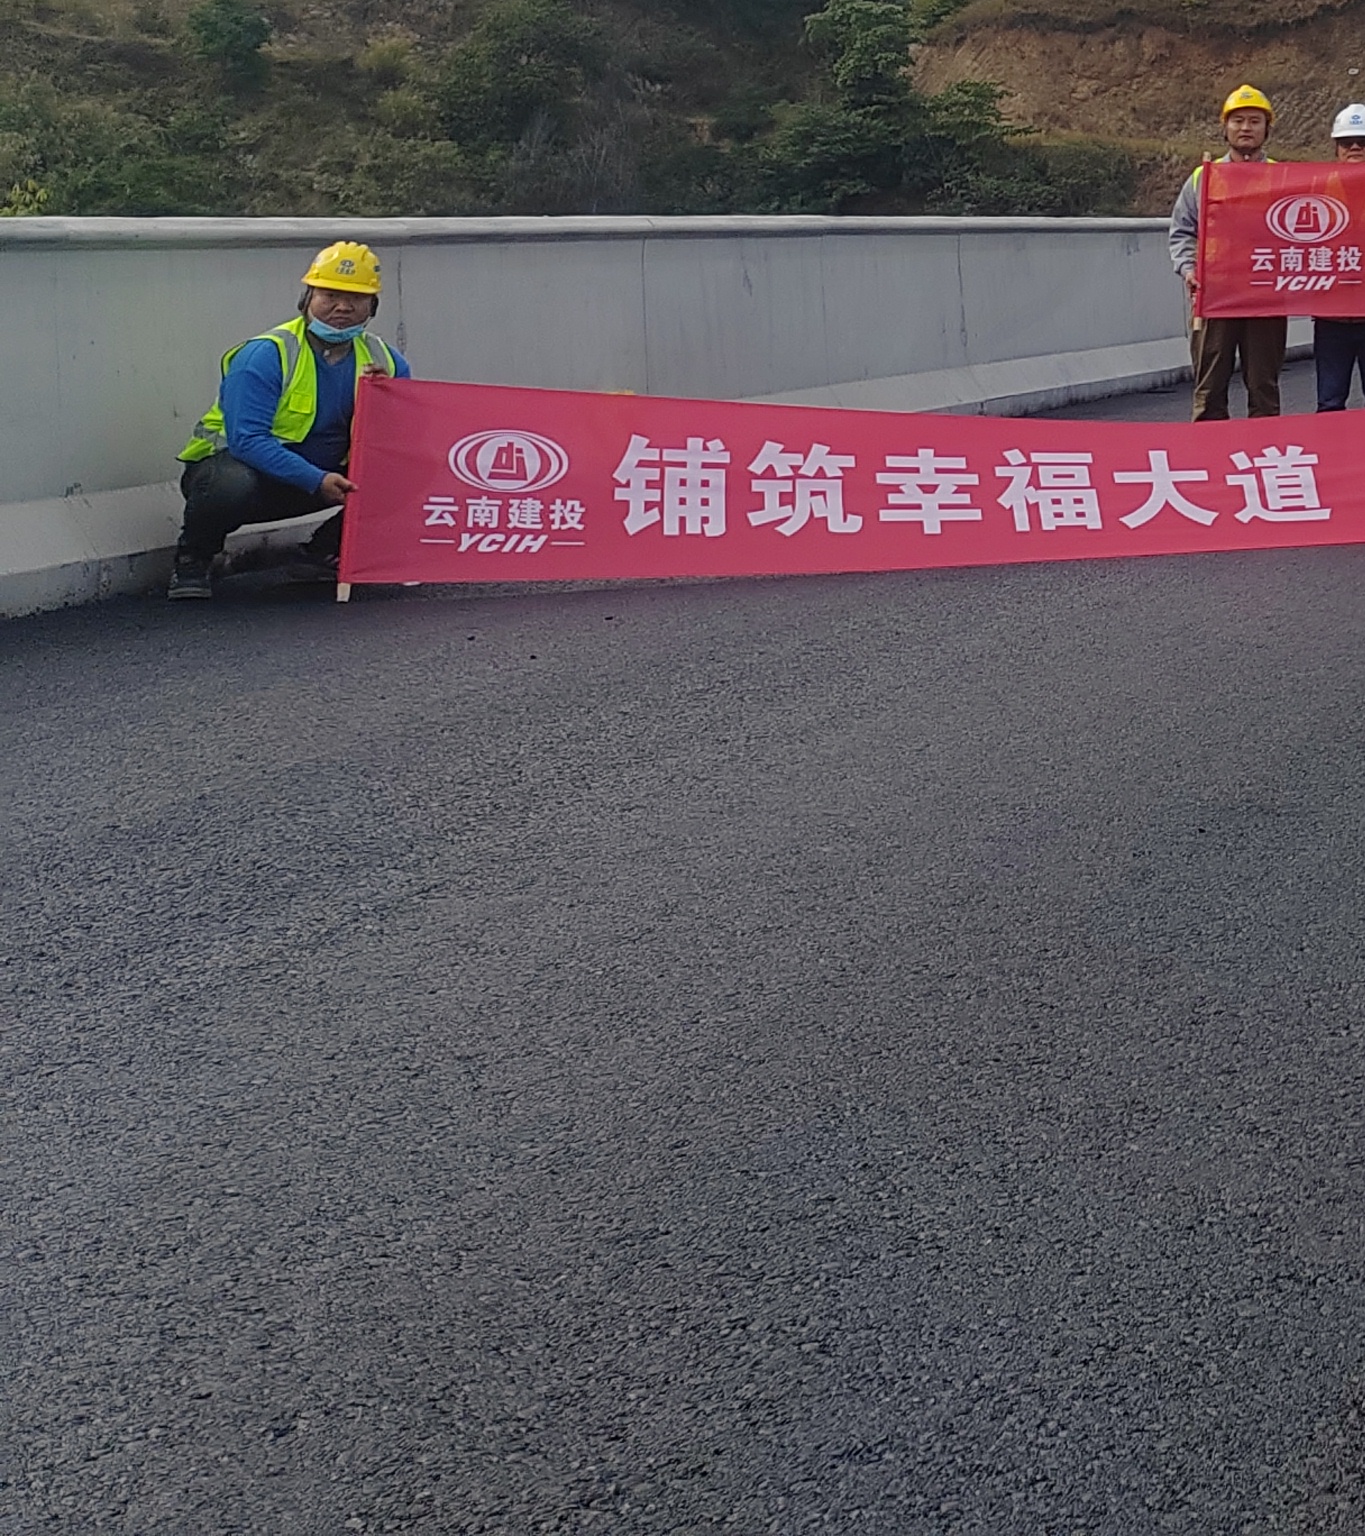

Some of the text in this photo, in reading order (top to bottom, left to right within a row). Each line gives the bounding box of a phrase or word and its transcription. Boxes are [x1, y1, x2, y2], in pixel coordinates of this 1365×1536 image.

[1250, 246, 1363, 272] 云南建投
[1274, 275, 1337, 292] YCIH
[611, 433, 1331, 538] 铺筑幸福大道
[421, 495, 587, 531] 云南建投
[456, 532, 548, 554] YCIH
